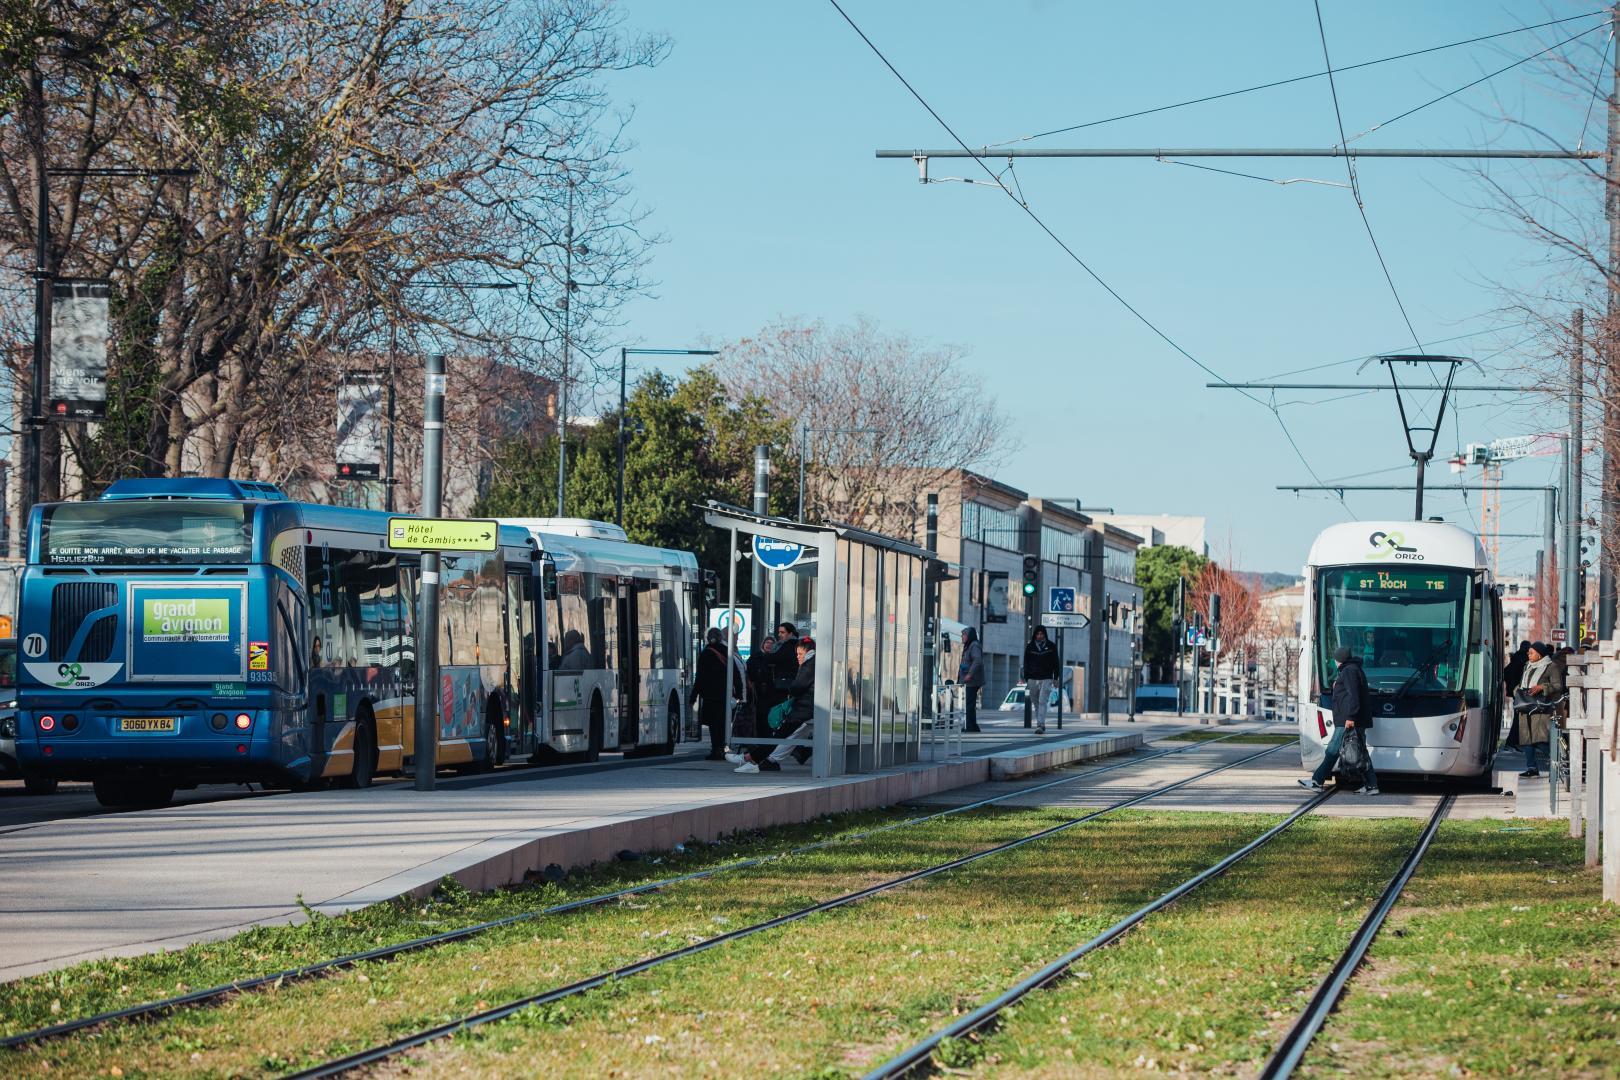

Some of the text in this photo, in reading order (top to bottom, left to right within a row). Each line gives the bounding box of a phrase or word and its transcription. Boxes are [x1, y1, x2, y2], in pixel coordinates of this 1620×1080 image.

[55, 365, 86, 377] viens
[407, 524, 434, 534] Hôtel
[407, 535, 418, 543] de
[49, 547, 57, 555] JE
[59, 547, 82, 555] QUITTE
[84, 547, 99, 555] MON
[101, 546, 123, 555] ARRÊT,
[124, 547, 145, 555] MERCI
[1377, 572, 1389, 580] T1
[1359, 579, 1444, 590] ST ROCH T15
[153, 599, 196, 620] grand
[161, 617, 222, 634] avignon
[27, 636, 42, 655] 70
[250, 671, 278, 682] 93535
[215, 683, 234, 691] grand
[218, 689, 244, 697] avignon
[122, 719, 171, 729] 3060 YX 84
